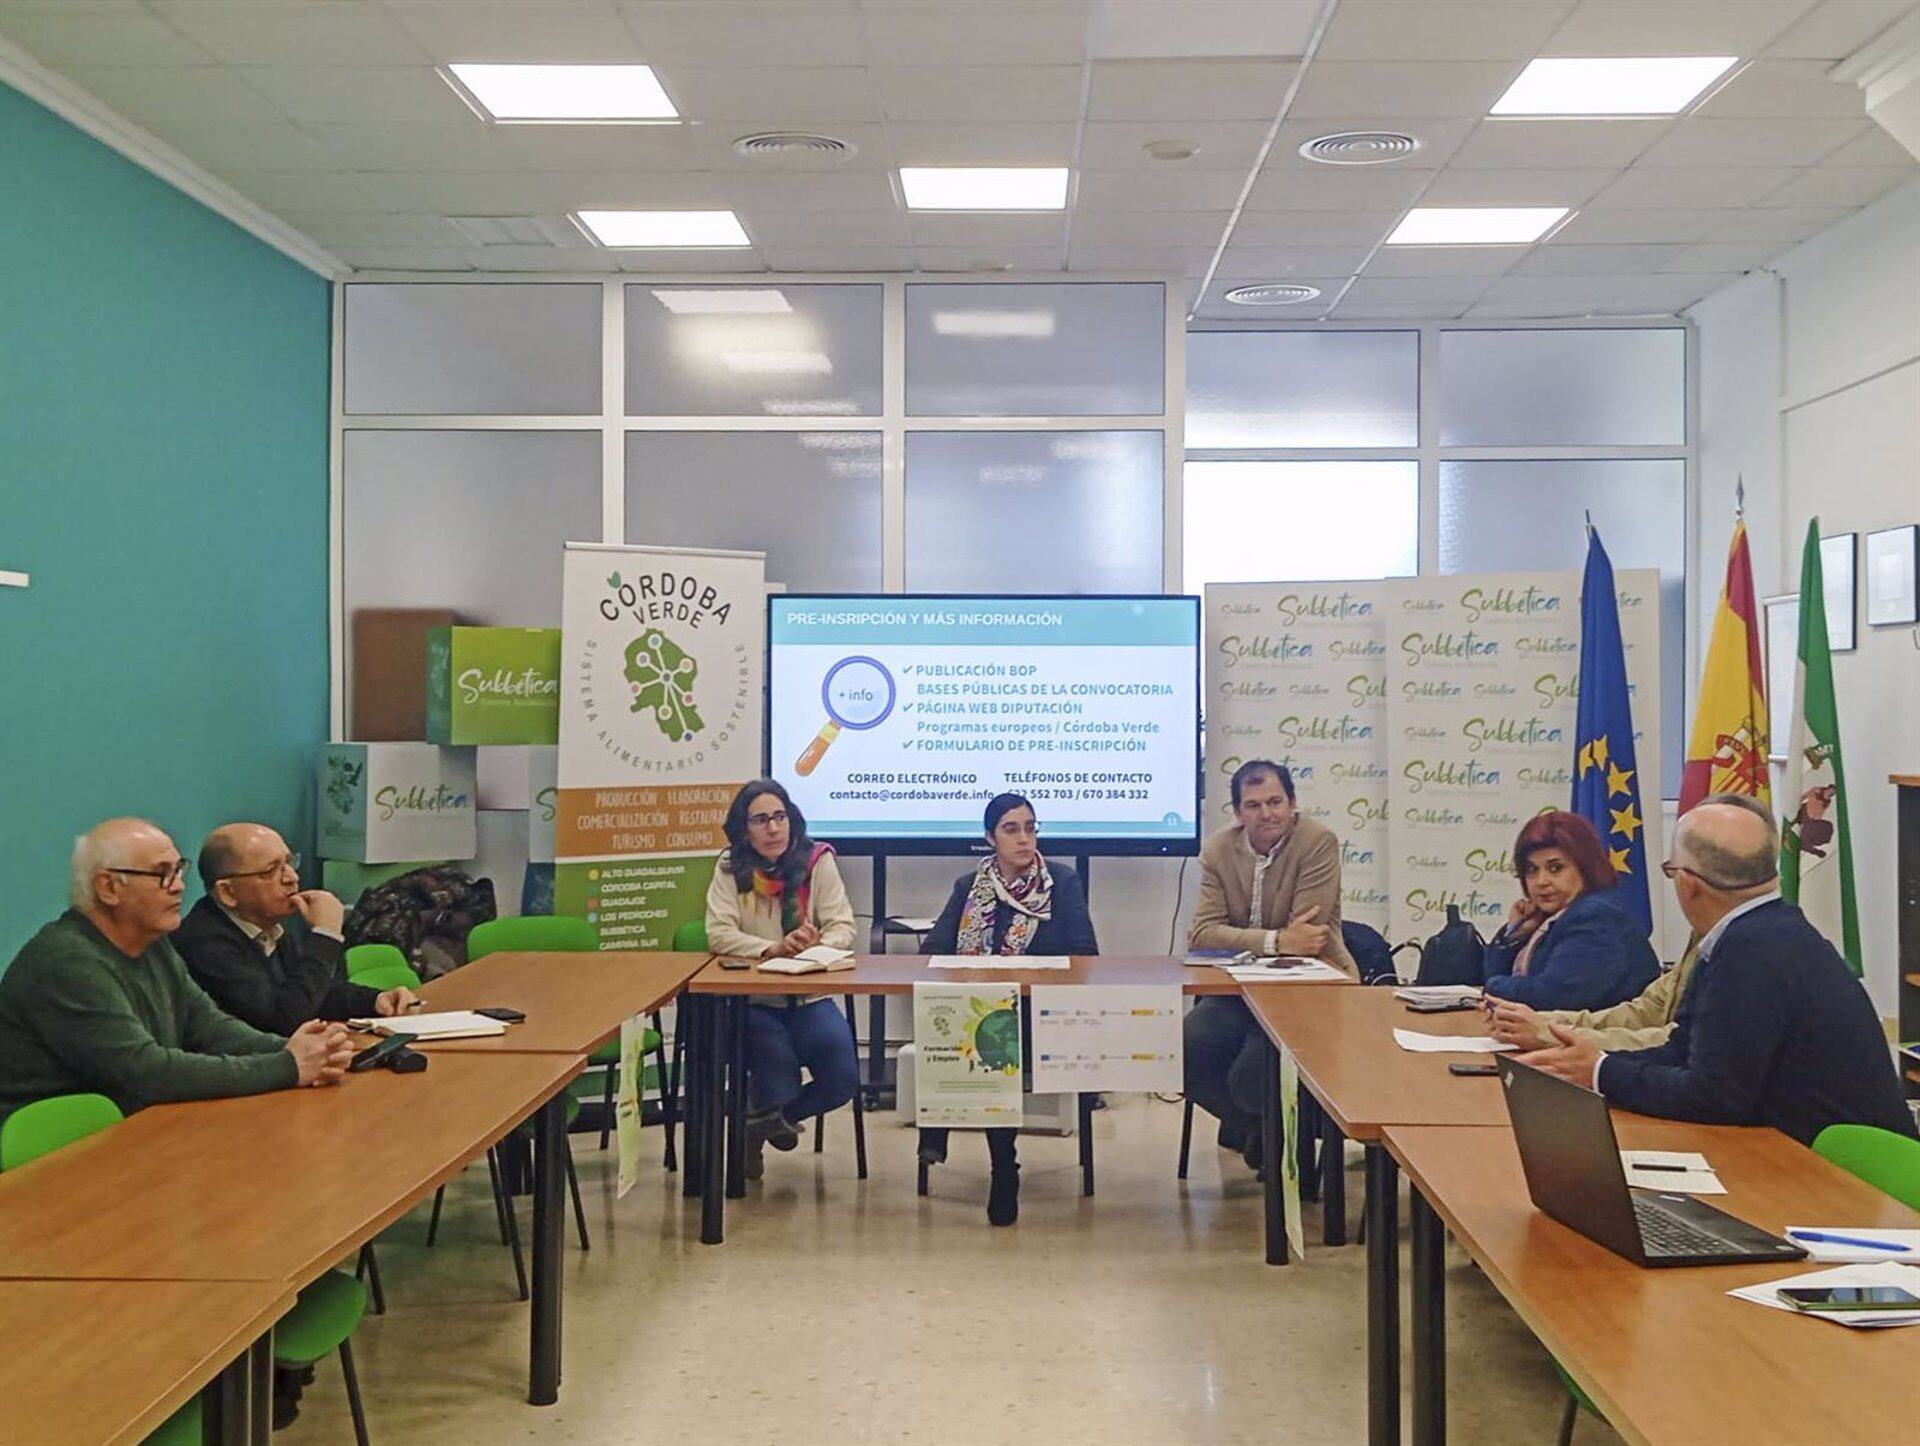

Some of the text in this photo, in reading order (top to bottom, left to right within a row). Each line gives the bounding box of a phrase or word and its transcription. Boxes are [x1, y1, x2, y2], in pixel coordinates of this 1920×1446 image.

[632, 601, 704, 629] VERDE
[911, 614, 921, 624] Y
[923, 611, 956, 625] MÁS
[959, 612, 1062, 626] INFORMACIÓN
[916, 663, 1037, 676] PUBLICACIÓN BOP
[457, 668, 558, 705] Subbetica
[917, 681, 1174, 695] BASES PÚBLICAS DE LA CONVOCATORIA
[849, 688, 873, 701] info
[580, 640, 749, 772] SISTEMA ALIMENTARIO SOSTENIBLE
[917, 700, 1083, 714] PÁGINA WEB DIPUTACIÓN
[917, 721, 987, 735] Programas
[991, 723, 1052, 735] europeos
[1063, 720, 1119, 733] Córdoba
[1123, 721, 1160, 733] Verde
[917, 737, 1146, 751] FORMULARIO DE PRE-INSCRIPCIÓN
[847, 771, 977, 784] CORREO ELECTRÓNICO
[1005, 771, 1153, 783] TELÉFONOS DE CONTACTO
[829, 790, 995, 802] contacto@cordobaverde.info
[1030, 789, 1051, 799] 552
[1053, 789, 1073, 799] 703
[1082, 789, 1103, 799] 670
[1128, 789, 1149, 799] 332
